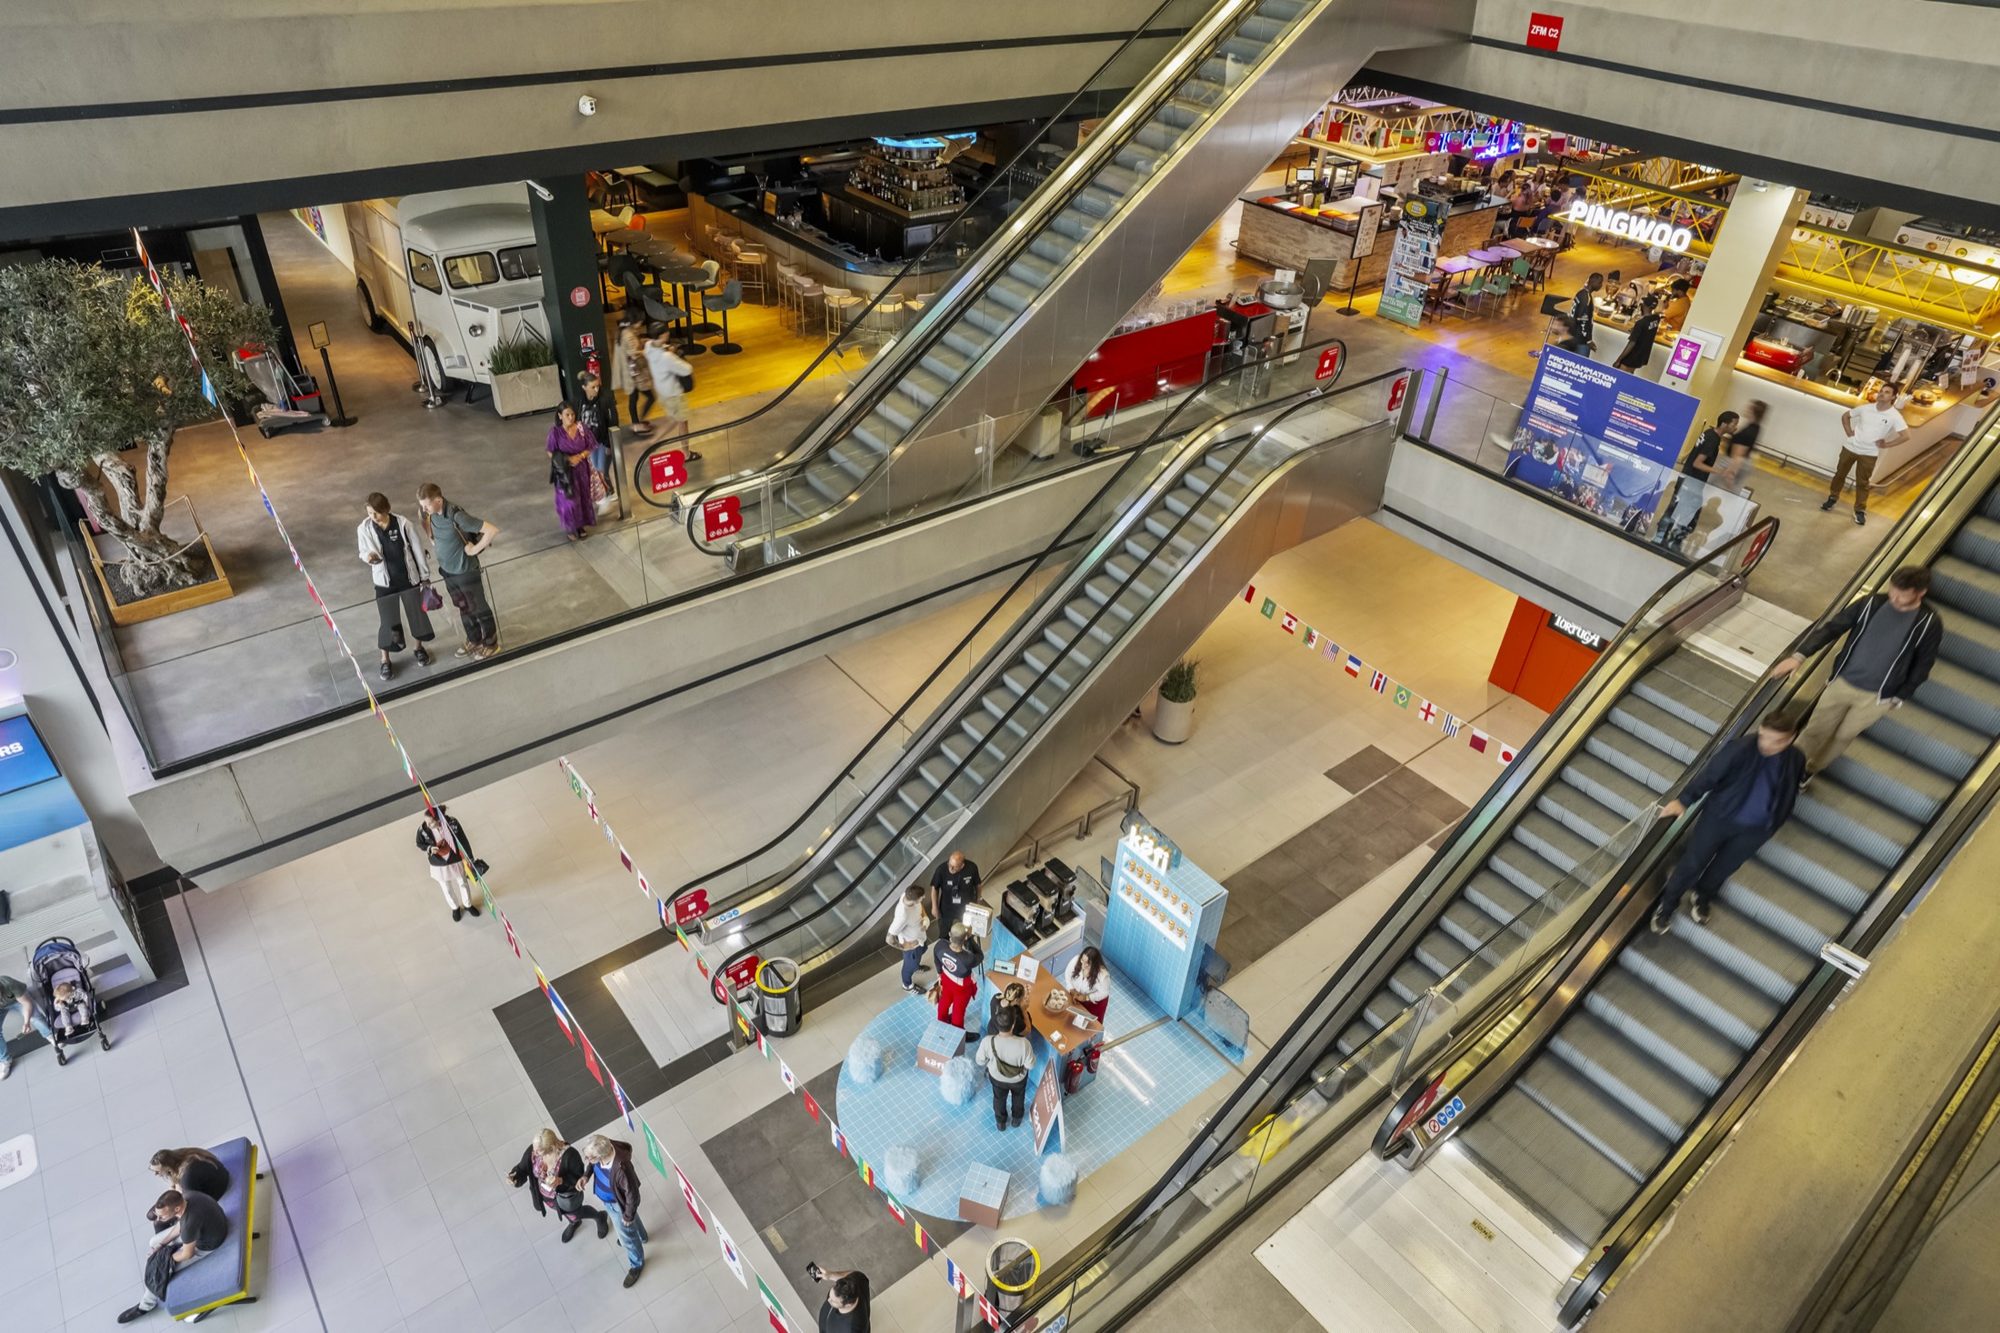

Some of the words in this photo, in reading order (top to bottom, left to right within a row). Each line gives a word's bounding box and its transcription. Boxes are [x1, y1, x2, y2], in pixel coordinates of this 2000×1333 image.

[1530, 25, 1548, 36] ZFM
[1548, 28, 1559, 39] C2
[1568, 200, 1692, 252] PINGWOO
[1546, 359, 1563, 371] DES
[1563, 366, 1612, 389] ANIMATIONS
[1548, 354, 1617, 384] PROGRAMMATION
[1554, 613, 1601, 648] TORTUGA
